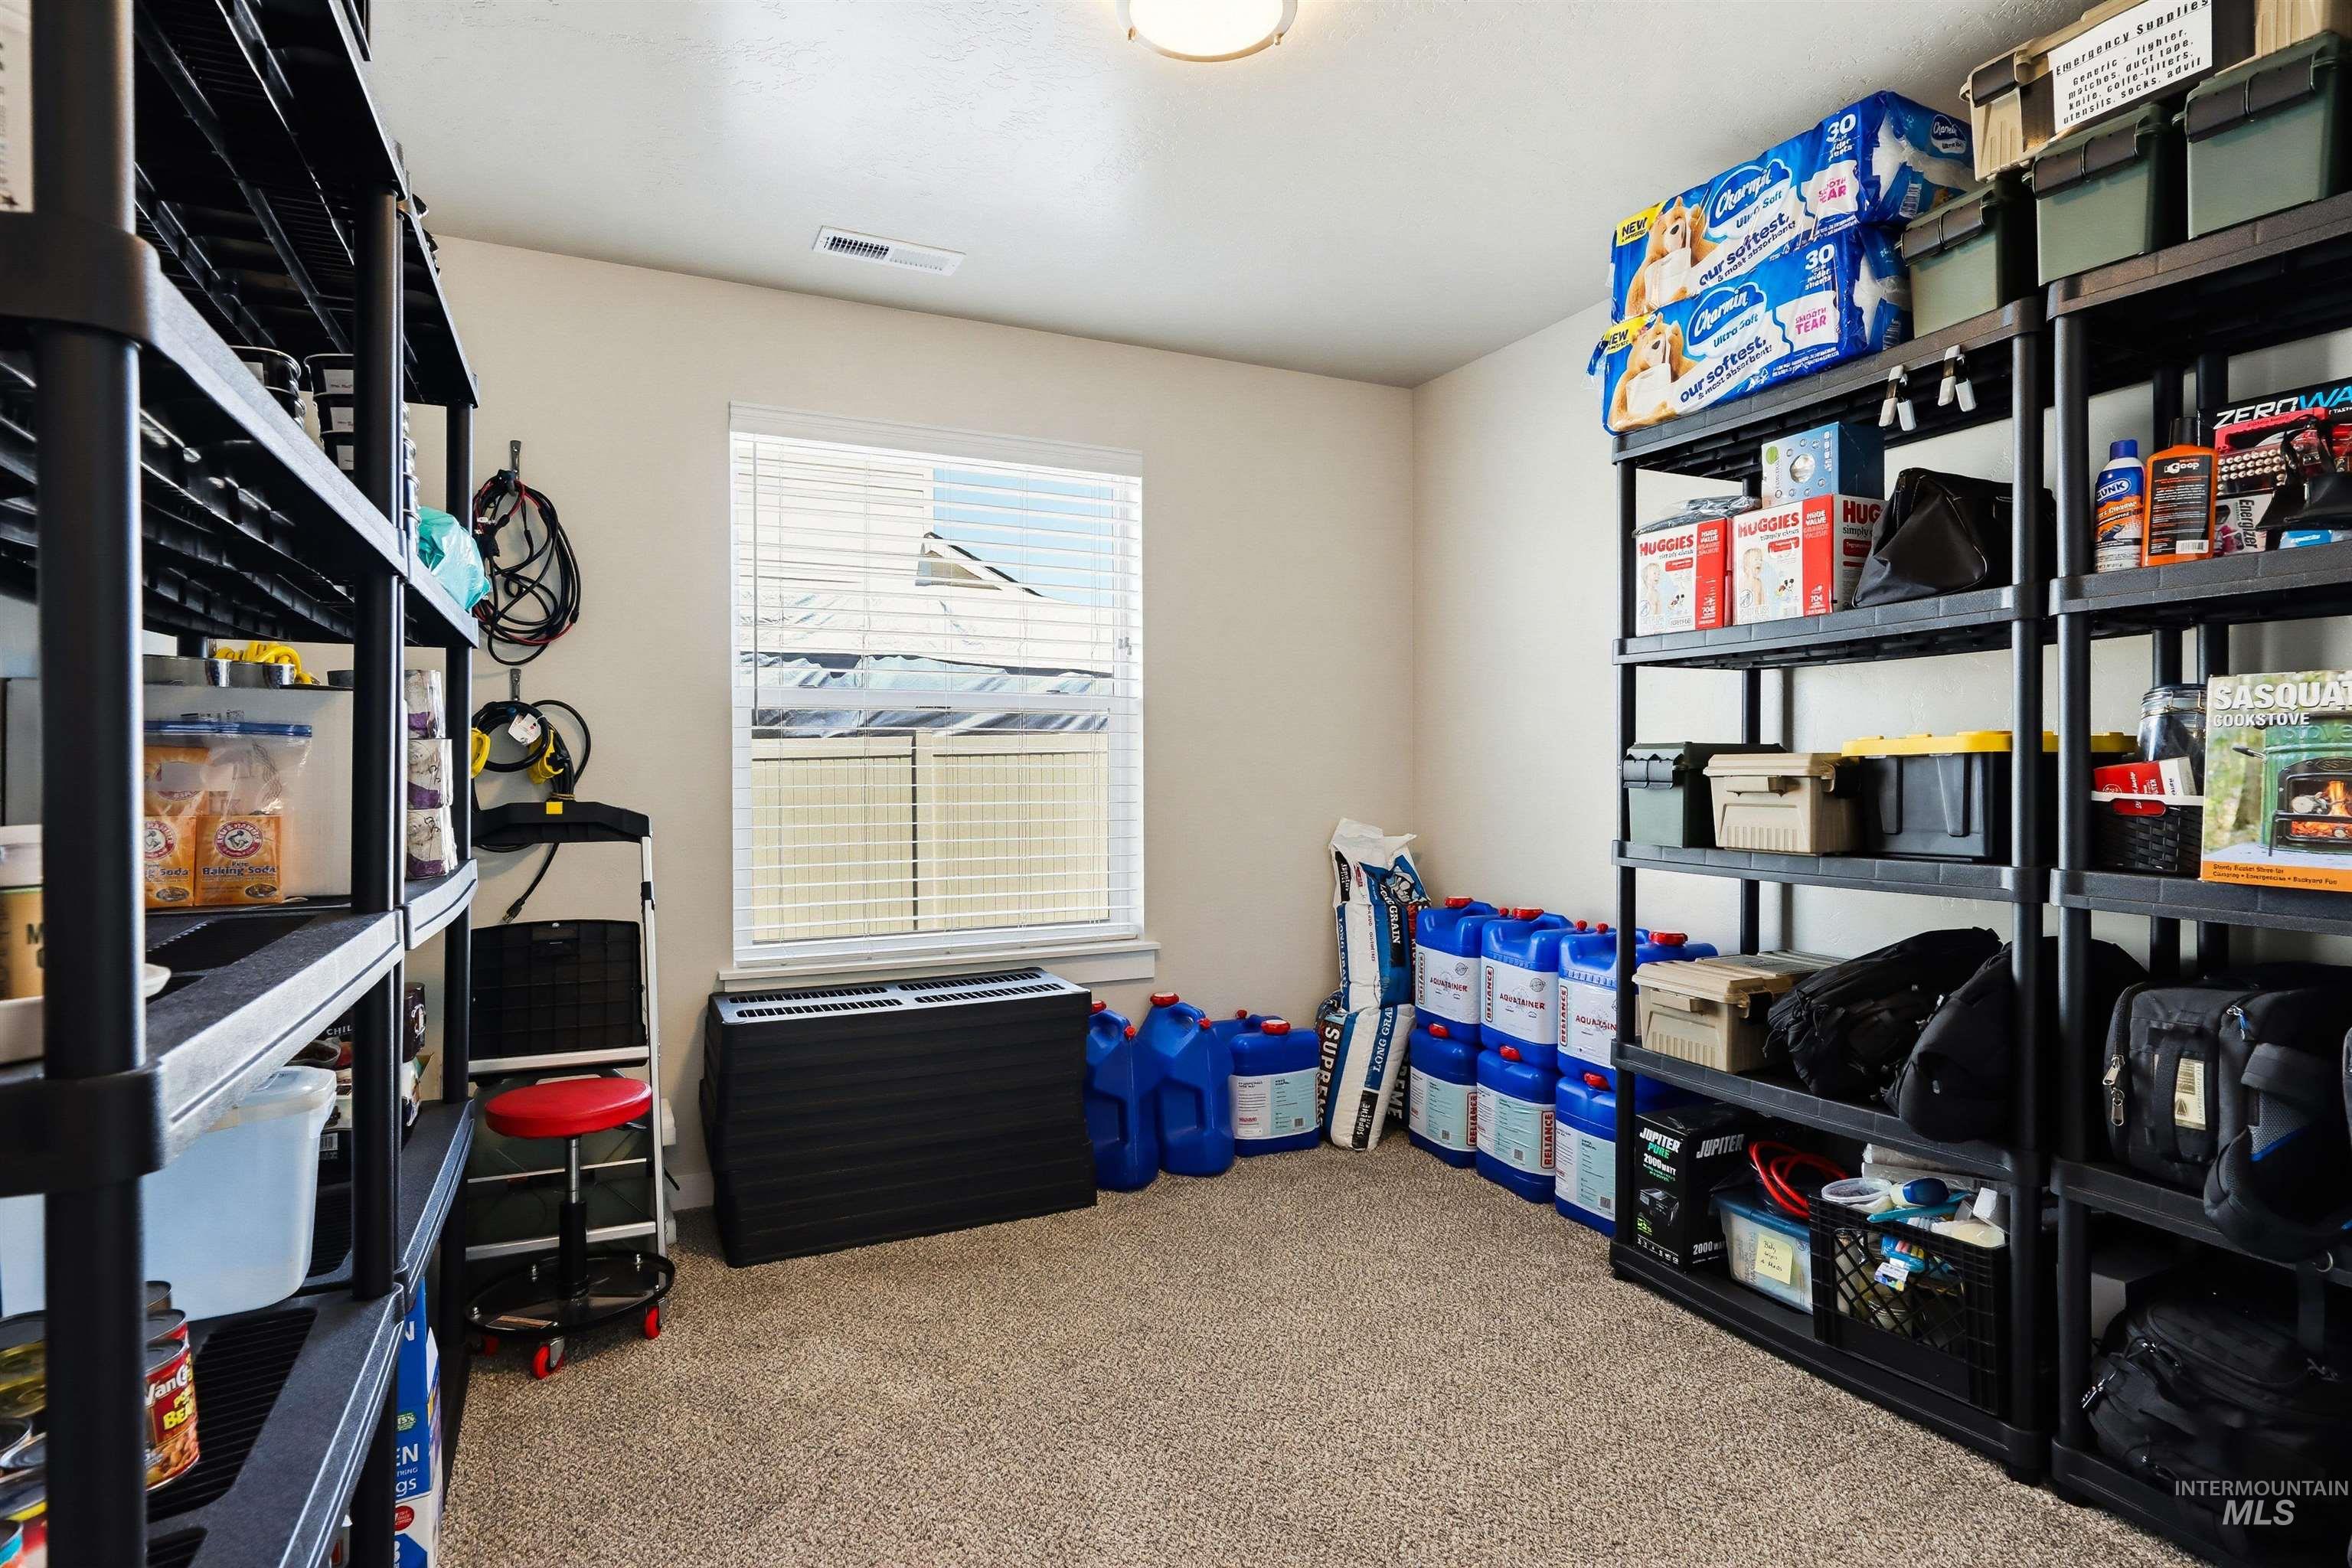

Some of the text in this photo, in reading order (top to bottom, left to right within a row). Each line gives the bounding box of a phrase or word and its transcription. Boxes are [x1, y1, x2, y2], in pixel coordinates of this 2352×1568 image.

[2056, 0, 2210, 76] Emergency Supplies
[2073, 59, 2118, 86] Generic
[2125, 55, 2154, 73] duct
[2167, 57, 2202, 78] advil
[1825, 113, 1857, 143] 30
[1762, 191, 1782, 209] Soft
[1621, 217, 1648, 237] NEW
[1698, 259, 1724, 286] our
[1726, 211, 1790, 266] softest,
[1805, 243, 1835, 270] 30
[1724, 257, 1747, 278] most
[1694, 287, 1749, 338] Charmin
[1795, 307, 1827, 324] SMOOTH
[1713, 312, 1759, 348] Ultra Soft
[1795, 315, 1828, 335] TEAR
[1680, 376, 1705, 403] our
[1707, 335, 1767, 382] softest,
[1705, 376, 1726, 397] most
[1725, 344, 1772, 380] absorbent!
[2165, 462, 2200, 474] Goop
[1738, 511, 1799, 538] HUGGIES
[1843, 525, 1869, 537] simply
[2238, 499, 2258, 548] Energizer
[1638, 534, 1694, 557] HUGGIES
[2213, 712, 2311, 728] COOKSTOVE
[160, 867, 189, 876] Soda
[202, 867, 244, 876] Baking
[2293, 876, 2323, 884] Backyard
[1389, 904, 1401, 944] GRAIN
[1429, 976, 1468, 993] AQUATAINER
[1499, 992, 1546, 1011] AQUATAINER
[1373, 1039, 1387, 1073] LONG
[1356, 1103, 1370, 1135] SUPREME
[1544, 1113, 1553, 1166] RELIANCE
[1639, 1127, 1681, 1153] JUPITER
[1647, 1142, 1671, 1159] PURE
[1696, 1134, 1745, 1159] JUPITER
[1692, 1240, 1713, 1256] 2000
